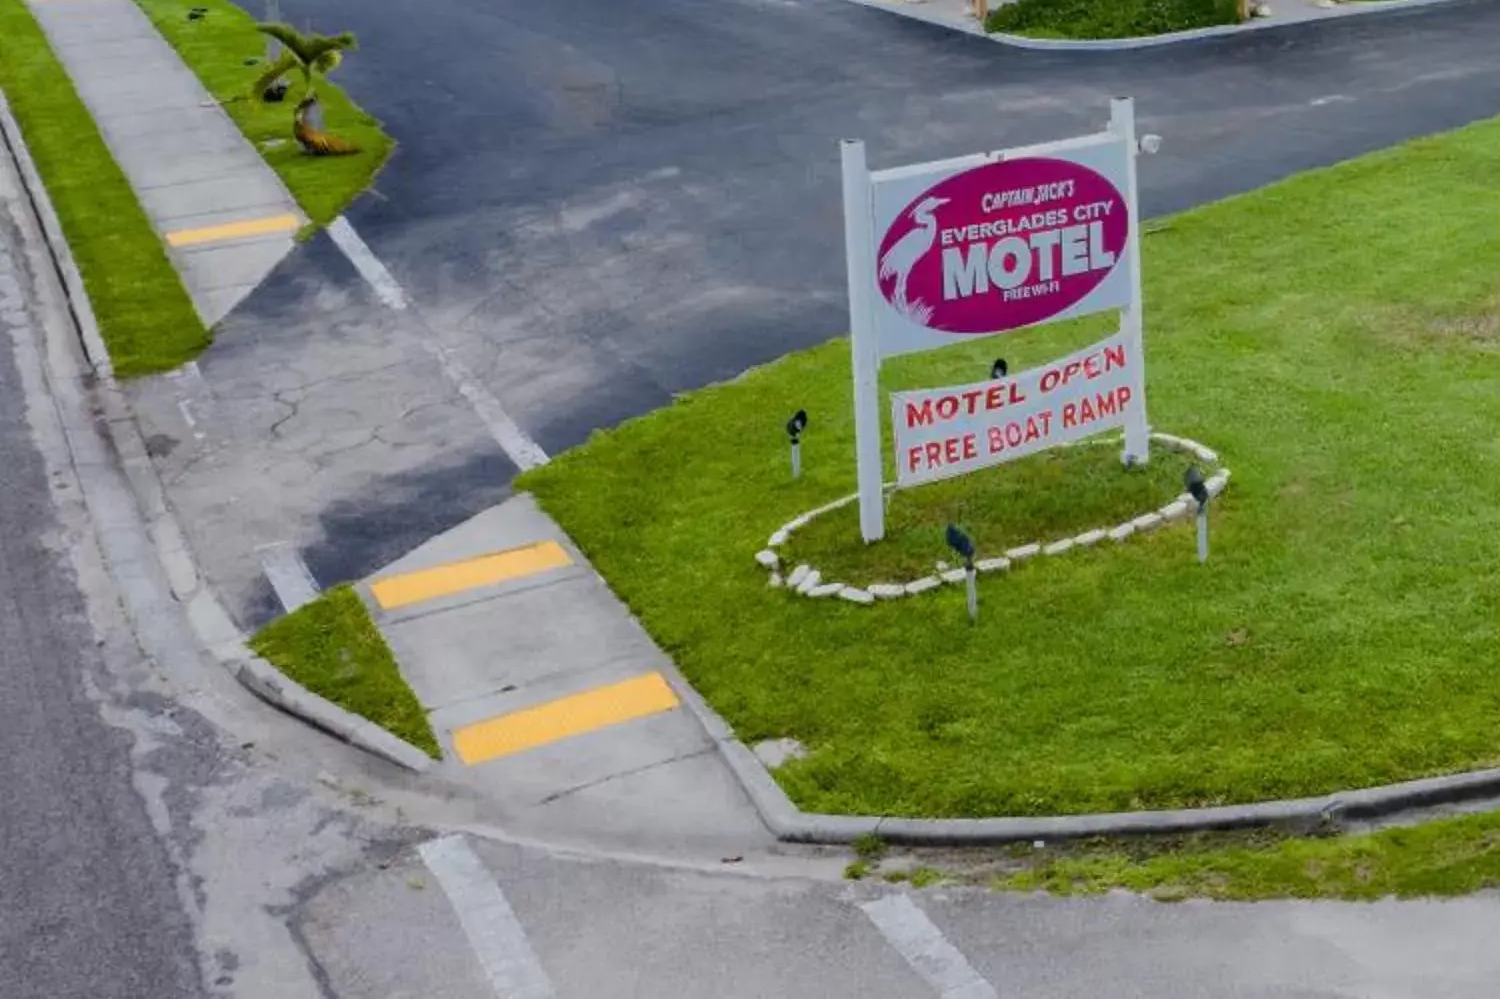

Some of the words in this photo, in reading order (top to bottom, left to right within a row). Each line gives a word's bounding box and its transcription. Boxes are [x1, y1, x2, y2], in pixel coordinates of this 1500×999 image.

[940, 208, 1068, 245] EVERGLADES
[1073, 200, 1114, 220] CITY
[982, 187, 1034, 213] CAPTAIN
[942, 221, 1116, 300] MOTEL
[1003, 286, 1030, 302] FREE
[906, 382, 1025, 428] MOTEL
[1039, 344, 1126, 393] OPEN
[908, 433, 977, 473] FREE
[987, 411, 1052, 455] BOAT
[1062, 386, 1131, 428] RAMP
